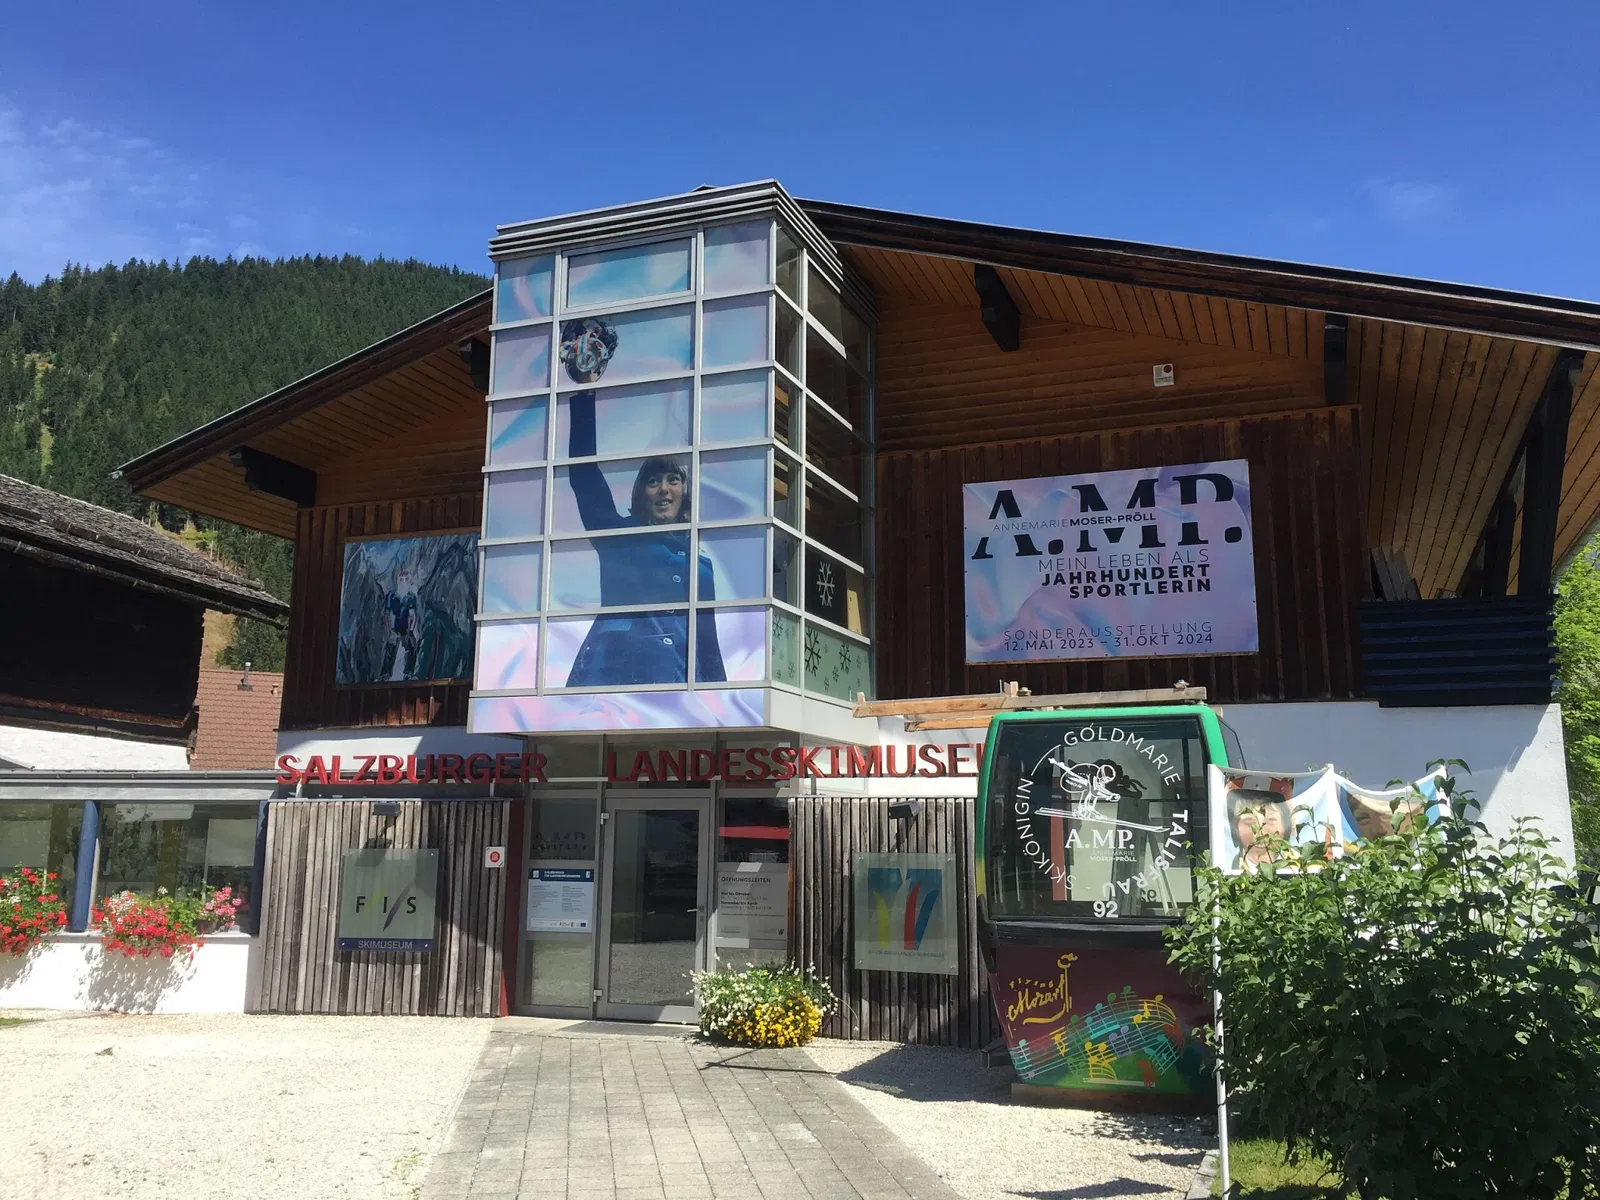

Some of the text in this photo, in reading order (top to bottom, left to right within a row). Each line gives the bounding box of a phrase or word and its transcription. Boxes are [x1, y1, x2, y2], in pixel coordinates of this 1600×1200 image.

[1038, 547, 1210, 573] MEIN LEBEN ALS
[1041, 563, 1211, 587] JAHRHUNDERT
[1069, 577, 1212, 599] SPORTLERIN
[1004, 621, 1213, 641] SONDERAUSSTELLUNG
[1060, 638, 1095, 649] 2023
[1176, 633, 1213, 645] 2024
[275, 752, 549, 785] SALZBURGER
[1092, 900, 1119, 918] 92
[357, 939, 414, 950] SKIMUSEUM
